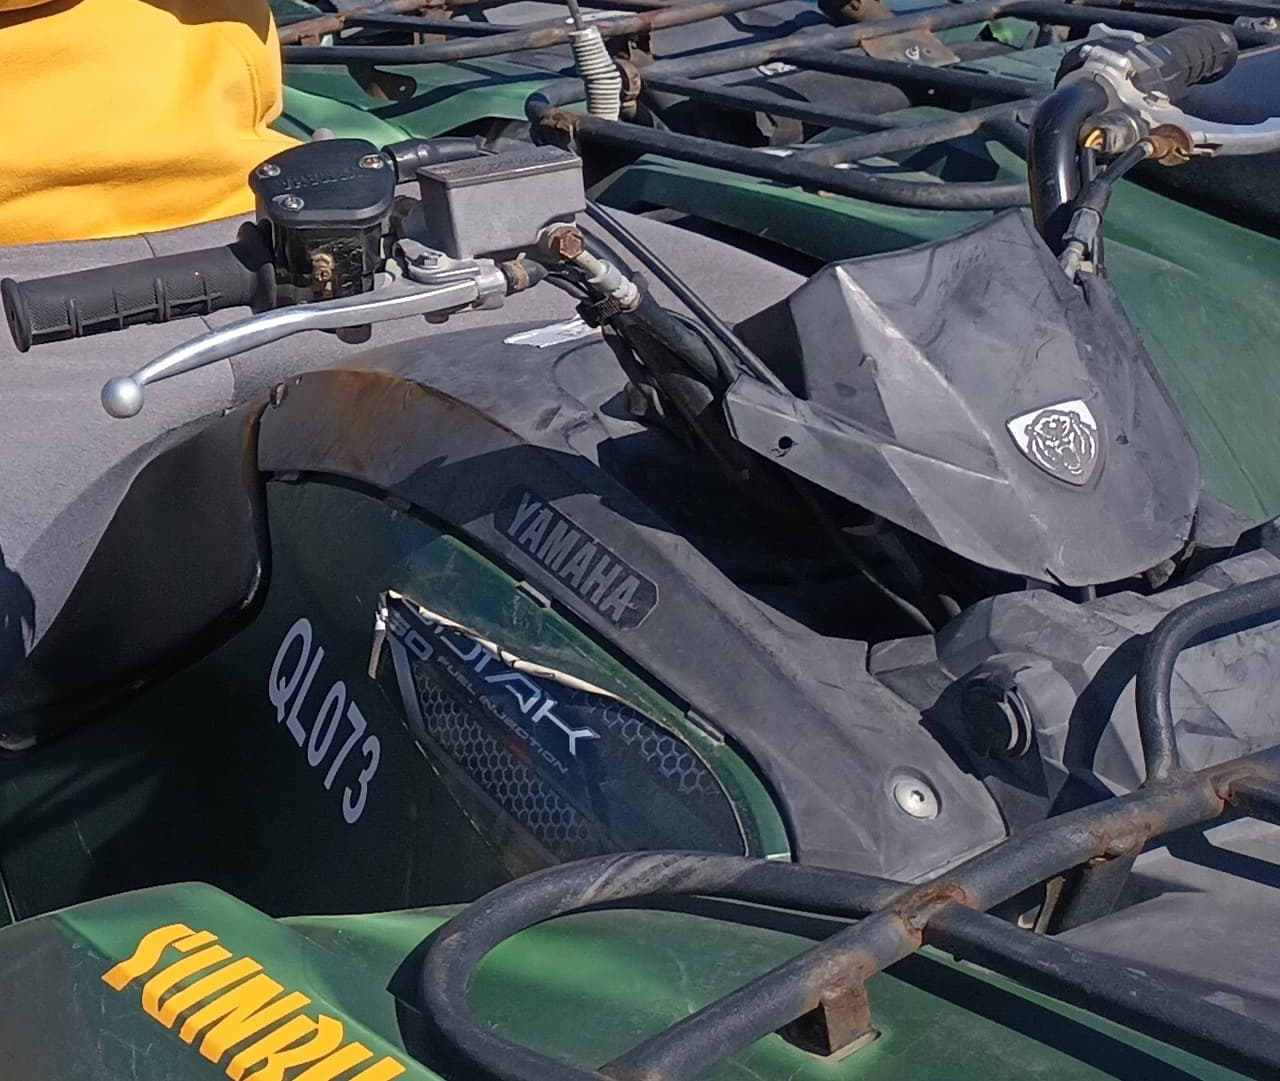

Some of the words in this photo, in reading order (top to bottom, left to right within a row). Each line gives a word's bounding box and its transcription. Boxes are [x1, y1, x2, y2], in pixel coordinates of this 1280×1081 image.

[507, 492, 641, 622] YAMAHA
[268, 617, 381, 824] QL073
[479, 695, 569, 774] INJECTION
